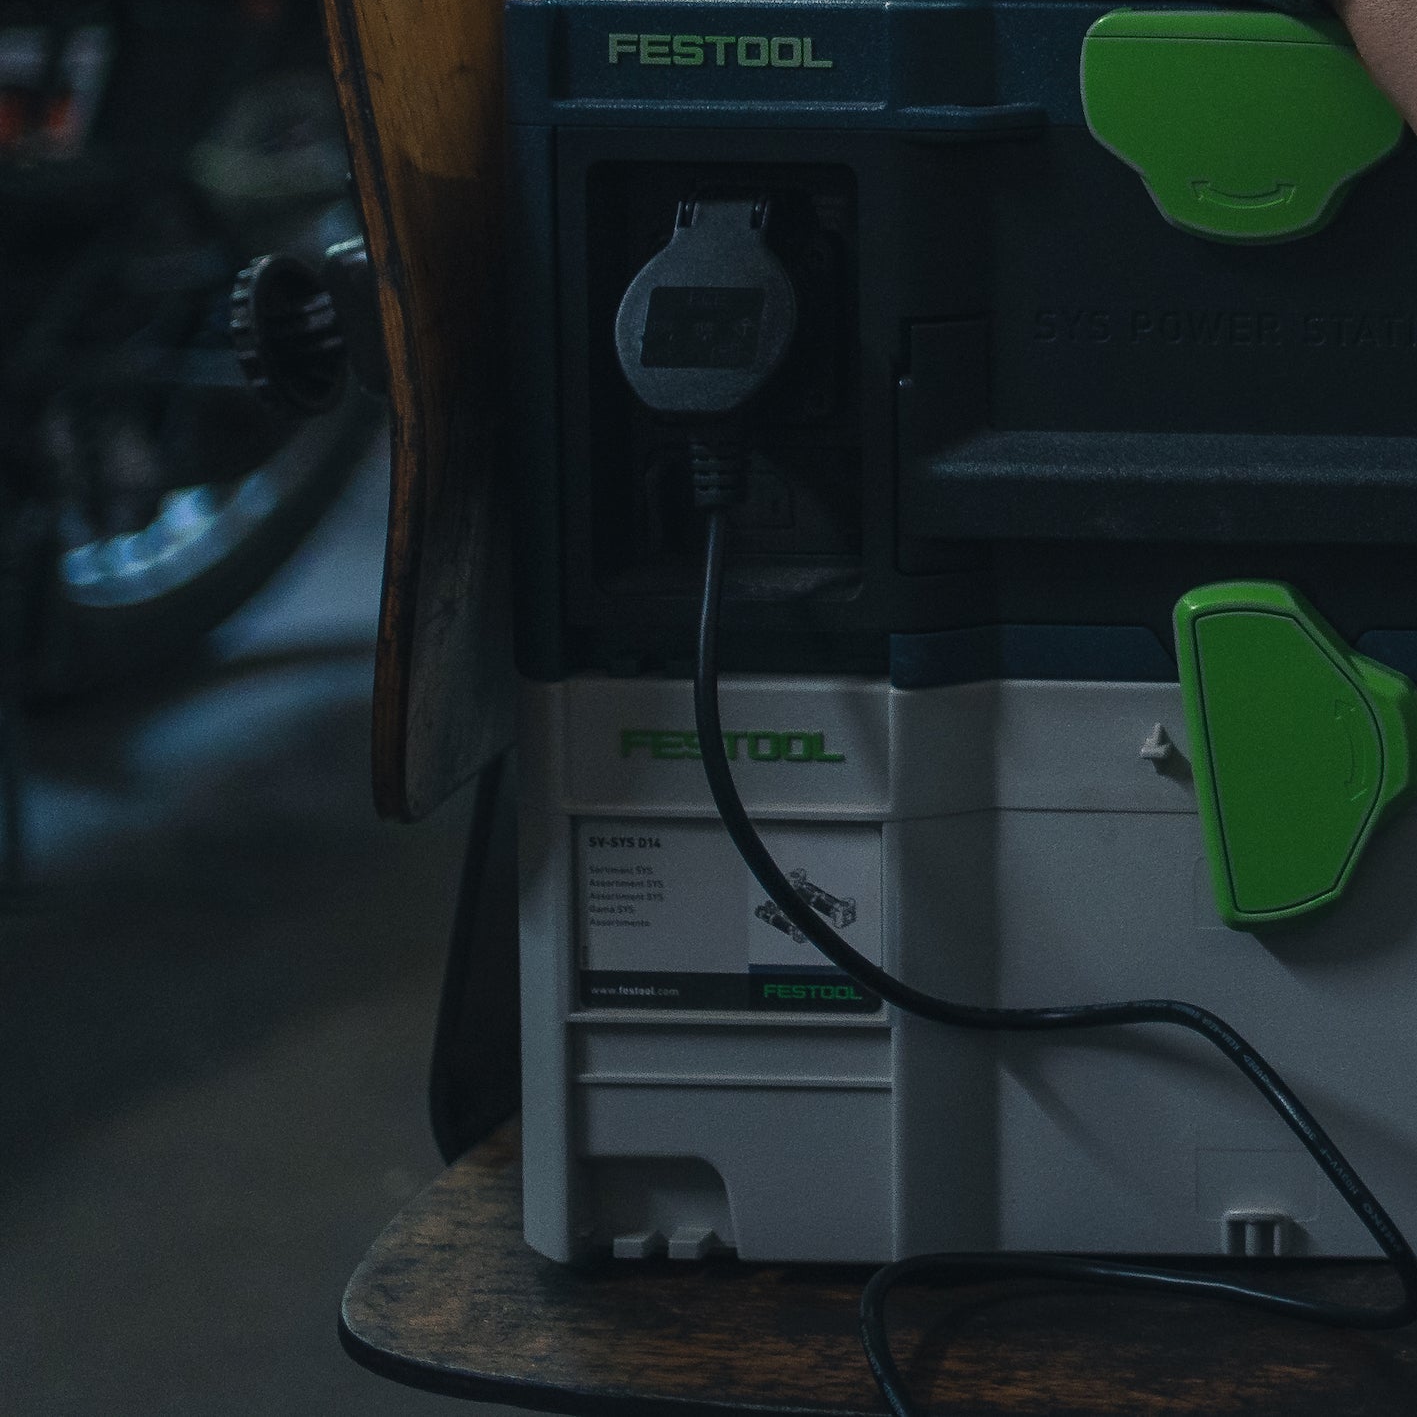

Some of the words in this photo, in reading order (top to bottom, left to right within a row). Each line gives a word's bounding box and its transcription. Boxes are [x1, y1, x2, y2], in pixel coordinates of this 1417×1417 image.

[608, 33, 833, 68] FESTOOL
[1033, 309, 1112, 345] SYS
[1130, 311, 1283, 347] POWER
[588, 836, 635, 849] SV-SYS
[638, 837, 662, 850] D14
[590, 985, 681, 997] www.festool.com
[763, 983, 864, 1001] FESTOOL
